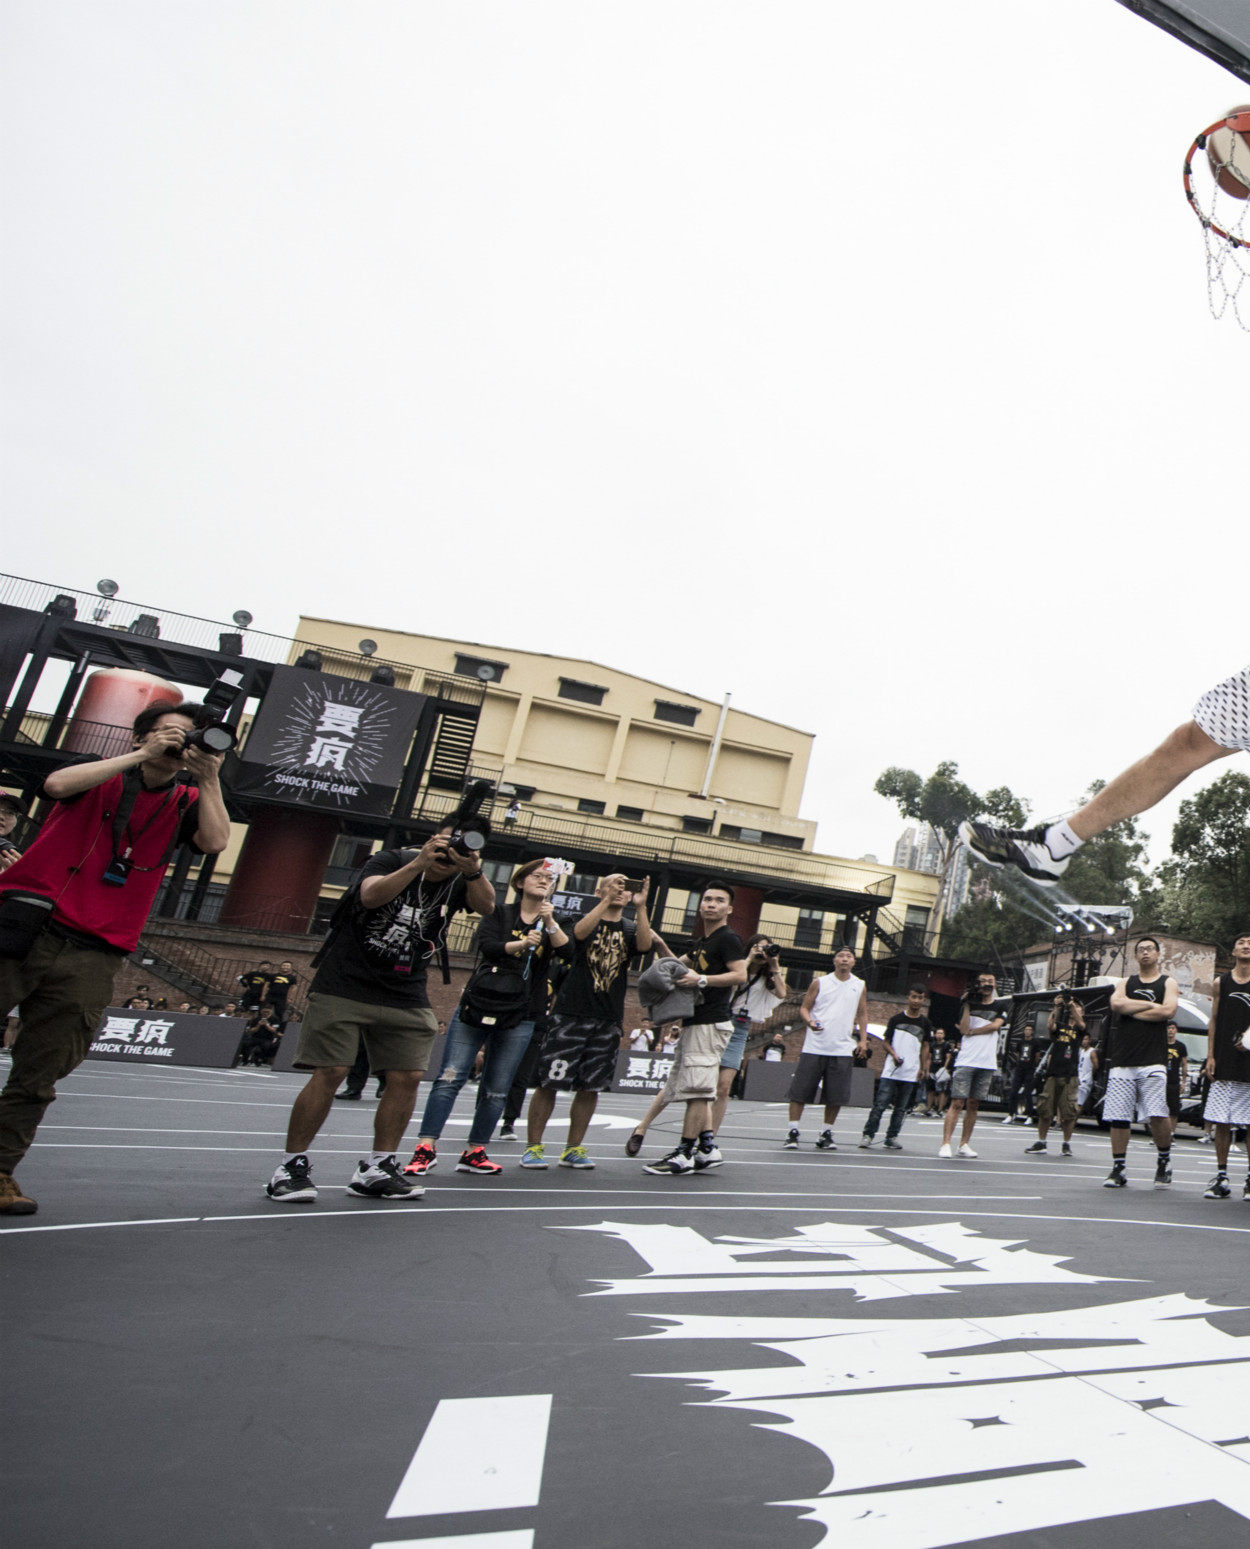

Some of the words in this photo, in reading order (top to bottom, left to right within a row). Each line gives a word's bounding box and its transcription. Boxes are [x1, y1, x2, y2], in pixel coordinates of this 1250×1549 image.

[303, 701, 366, 771] 要疯
[274, 774, 310, 788] SHOCK
[311, 779, 330, 791] THE
[330, 783, 360, 797] GAME
[98, 1016, 176, 1045] 要疯
[123, 1045, 144, 1055] THE
[143, 1046, 175, 1057] GAME
[548, 1059, 569, 1080] 8
[618, 1078, 644, 1088] SHOCK
[644, 1080, 660, 1089] THE
